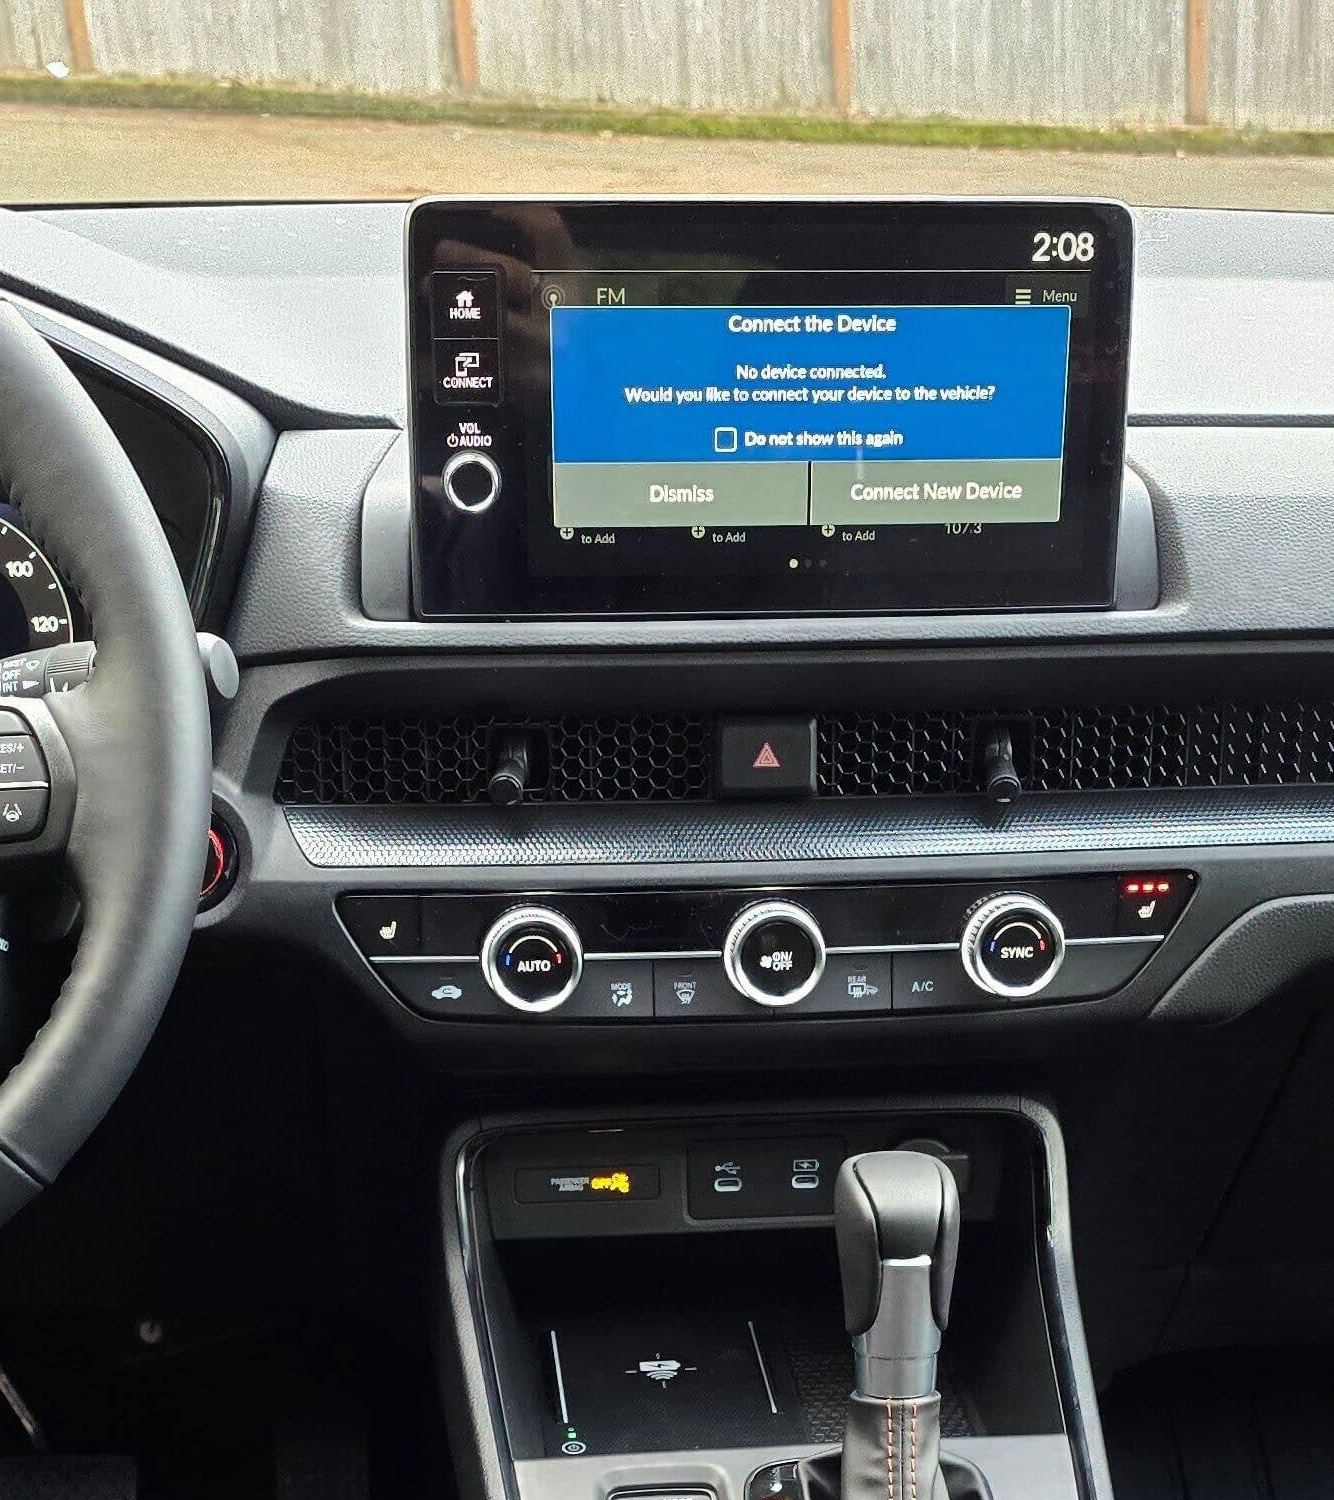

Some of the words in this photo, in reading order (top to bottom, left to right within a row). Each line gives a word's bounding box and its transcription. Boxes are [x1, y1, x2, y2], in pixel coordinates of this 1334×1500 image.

[1031, 232, 1095, 262] 2:08
[596, 287, 626, 305] FM
[1042, 289, 1078, 302] Menu
[449, 308, 481, 320] HOME
[728, 315, 801, 333] Connect
[804, 315, 834, 332] the
[837, 314, 897, 332] Device
[736, 364, 758, 380] No
[761, 363, 807, 380] device
[809, 363, 887, 380] connected.
[442, 376, 493, 389] CONNECT
[624, 386, 673, 403] Would
[676, 388, 703, 405] you
[706, 386, 730, 402] like
[733, 387, 749, 402] to
[752, 387, 808, 402] connect
[812, 388, 845, 404] your
[847, 386, 892, 401] device
[895, 387, 911, 401] to
[914, 385, 937, 401] the
[940, 385, 996, 400] vehicle?
[458, 423, 481, 434] VOL
[459, 435, 492, 447] AUDIO
[744, 431, 766, 447] Do
[769, 431, 794, 446] not
[796, 430, 835, 446] show
[836, 430, 863, 446] this
[865, 430, 904, 448] again
[649, 484, 715, 503] Dismiss
[850, 482, 921, 501] Connect
[923, 482, 963, 500] New
[966, 481, 1024, 499] Device
[580, 533, 593, 544] to
[594, 532, 616, 544] Add
[712, 532, 724, 543] to
[725, 531, 747, 544] Add
[842, 531, 854, 542] to
[854, 530, 876, 542] Add
[5, 560, 34, 578] 100
[30, 616, 59, 633] 120
[1, 669, 21, 681] OFF
[2, 681, 18, 692] INT
[772, 950, 793, 961] ON/
[1000, 946, 1034, 959] SYNC
[517, 959, 551, 972] AUTO
[772, 961, 793, 971] OFF
[673, 981, 697, 990] FRONT
[911, 981, 934, 993] A/C
